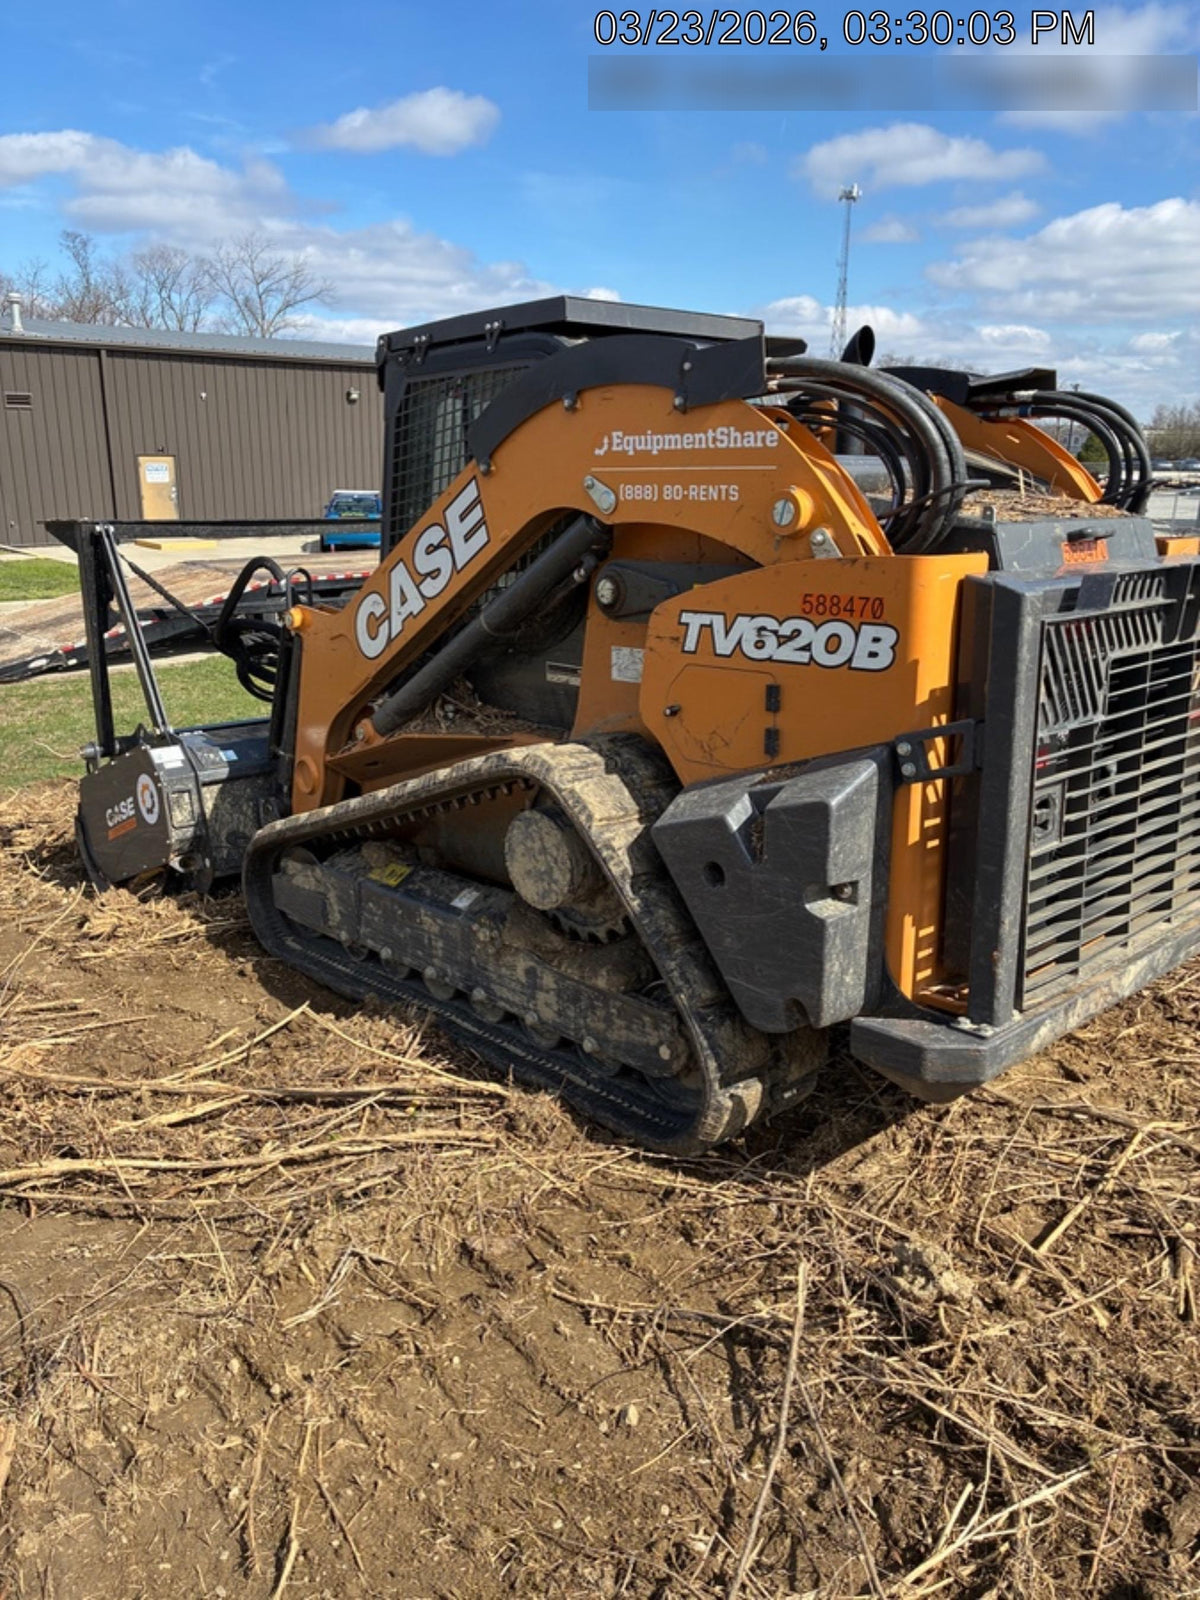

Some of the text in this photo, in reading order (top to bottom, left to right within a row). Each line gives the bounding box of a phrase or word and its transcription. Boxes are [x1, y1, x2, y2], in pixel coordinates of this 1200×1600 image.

[610, 426, 779, 456] EquipmentShare
[618, 484, 659, 501] (888)
[356, 475, 490, 660] CASE
[801, 593, 884, 619] 588470
[678, 609, 899, 672] TV620B
[105, 796, 136, 828] CASE
